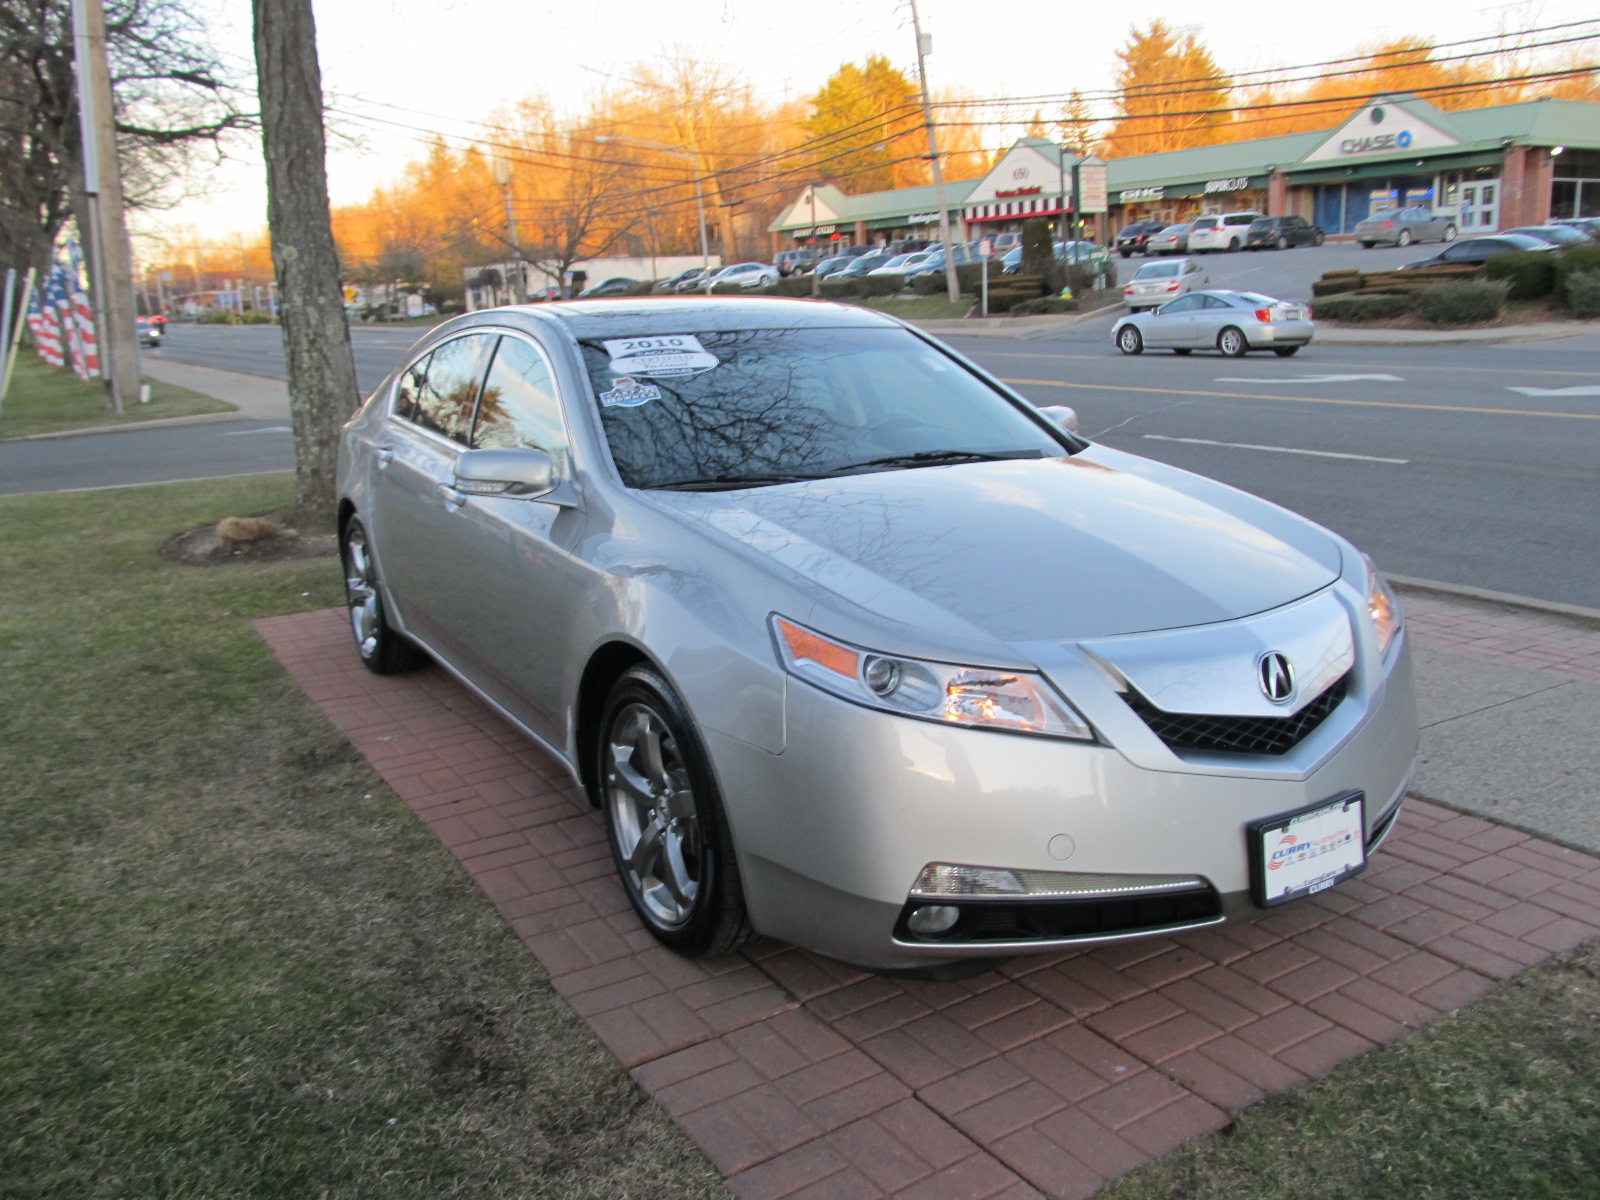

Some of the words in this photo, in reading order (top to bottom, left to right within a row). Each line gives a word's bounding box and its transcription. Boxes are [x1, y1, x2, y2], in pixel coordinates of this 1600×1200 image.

[1342, 133, 1397, 153] CHASE
[1119, 186, 1167, 200] GNC
[622, 338, 684, 350] 2010
[631, 355, 694, 364] CERTIFIED
[1272, 840, 1313, 860] CURRY
